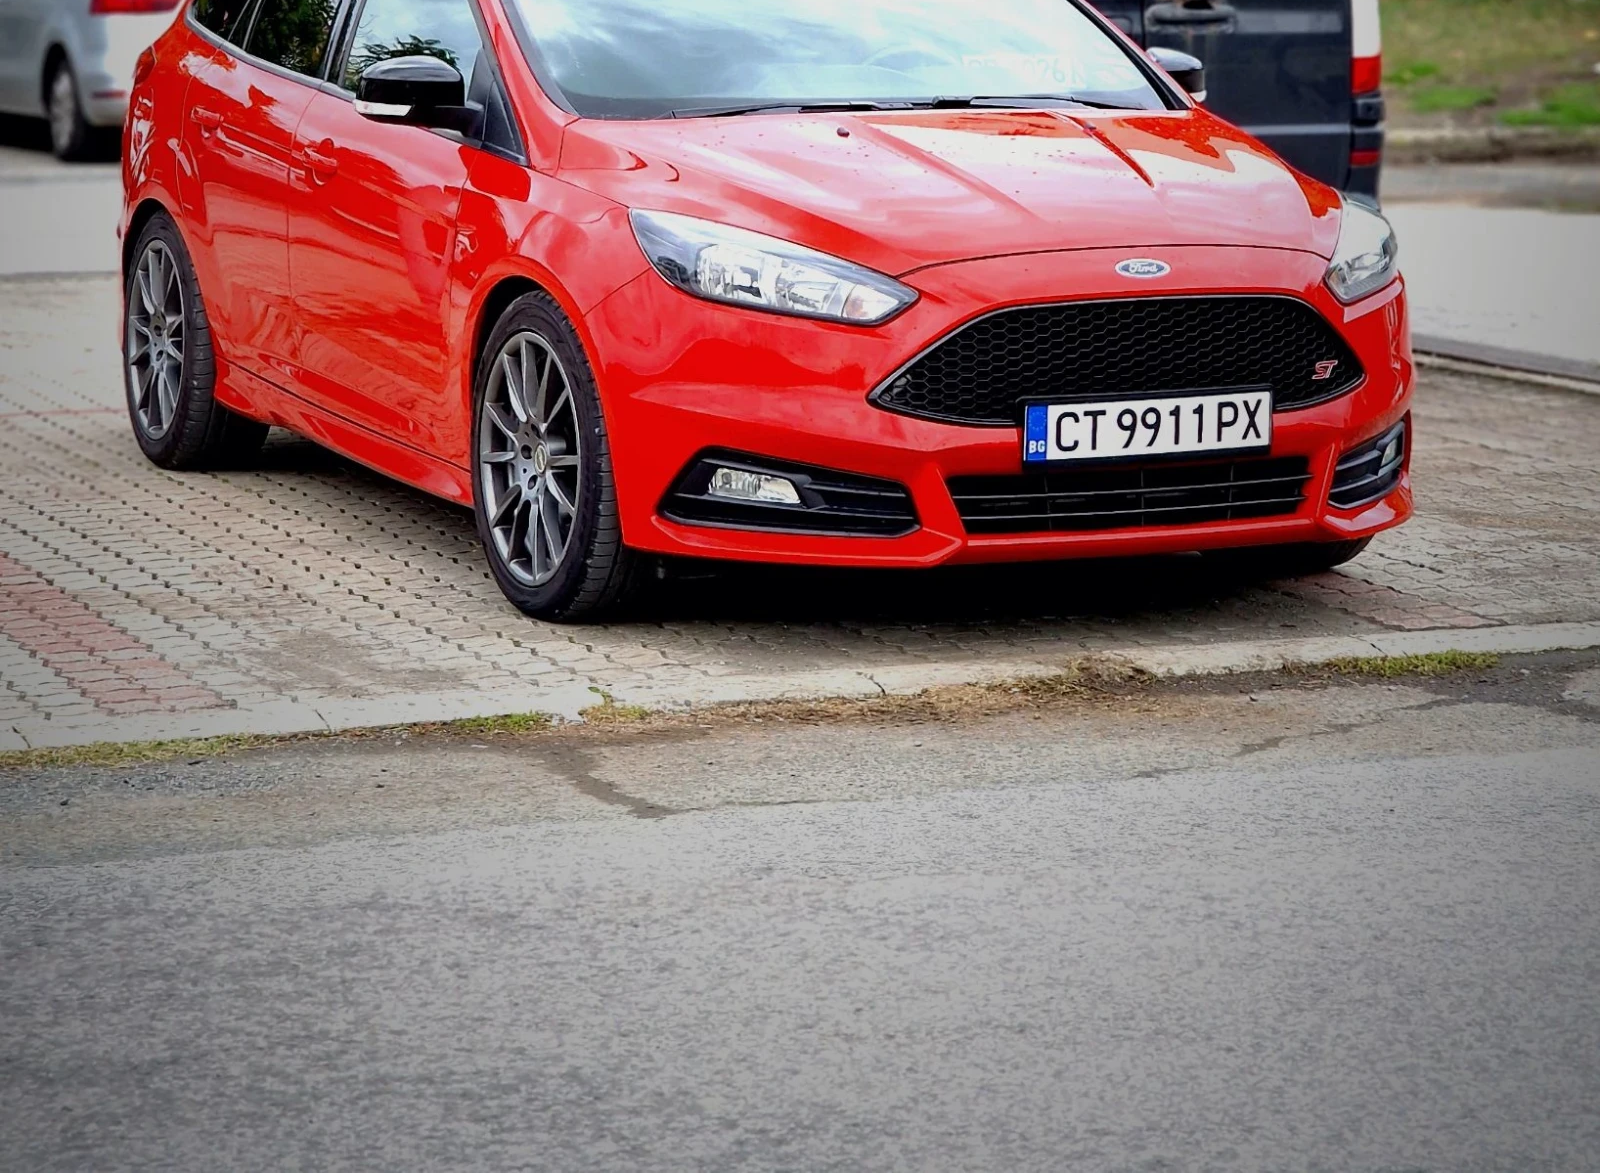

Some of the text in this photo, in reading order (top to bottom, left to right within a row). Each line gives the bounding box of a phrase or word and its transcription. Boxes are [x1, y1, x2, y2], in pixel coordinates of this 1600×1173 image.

[1128, 261, 1159, 274] Ford
[1311, 359, 1339, 380] ST
[1055, 398, 1262, 452] CT 9911 PX
[1028, 439, 1046, 454] BG
